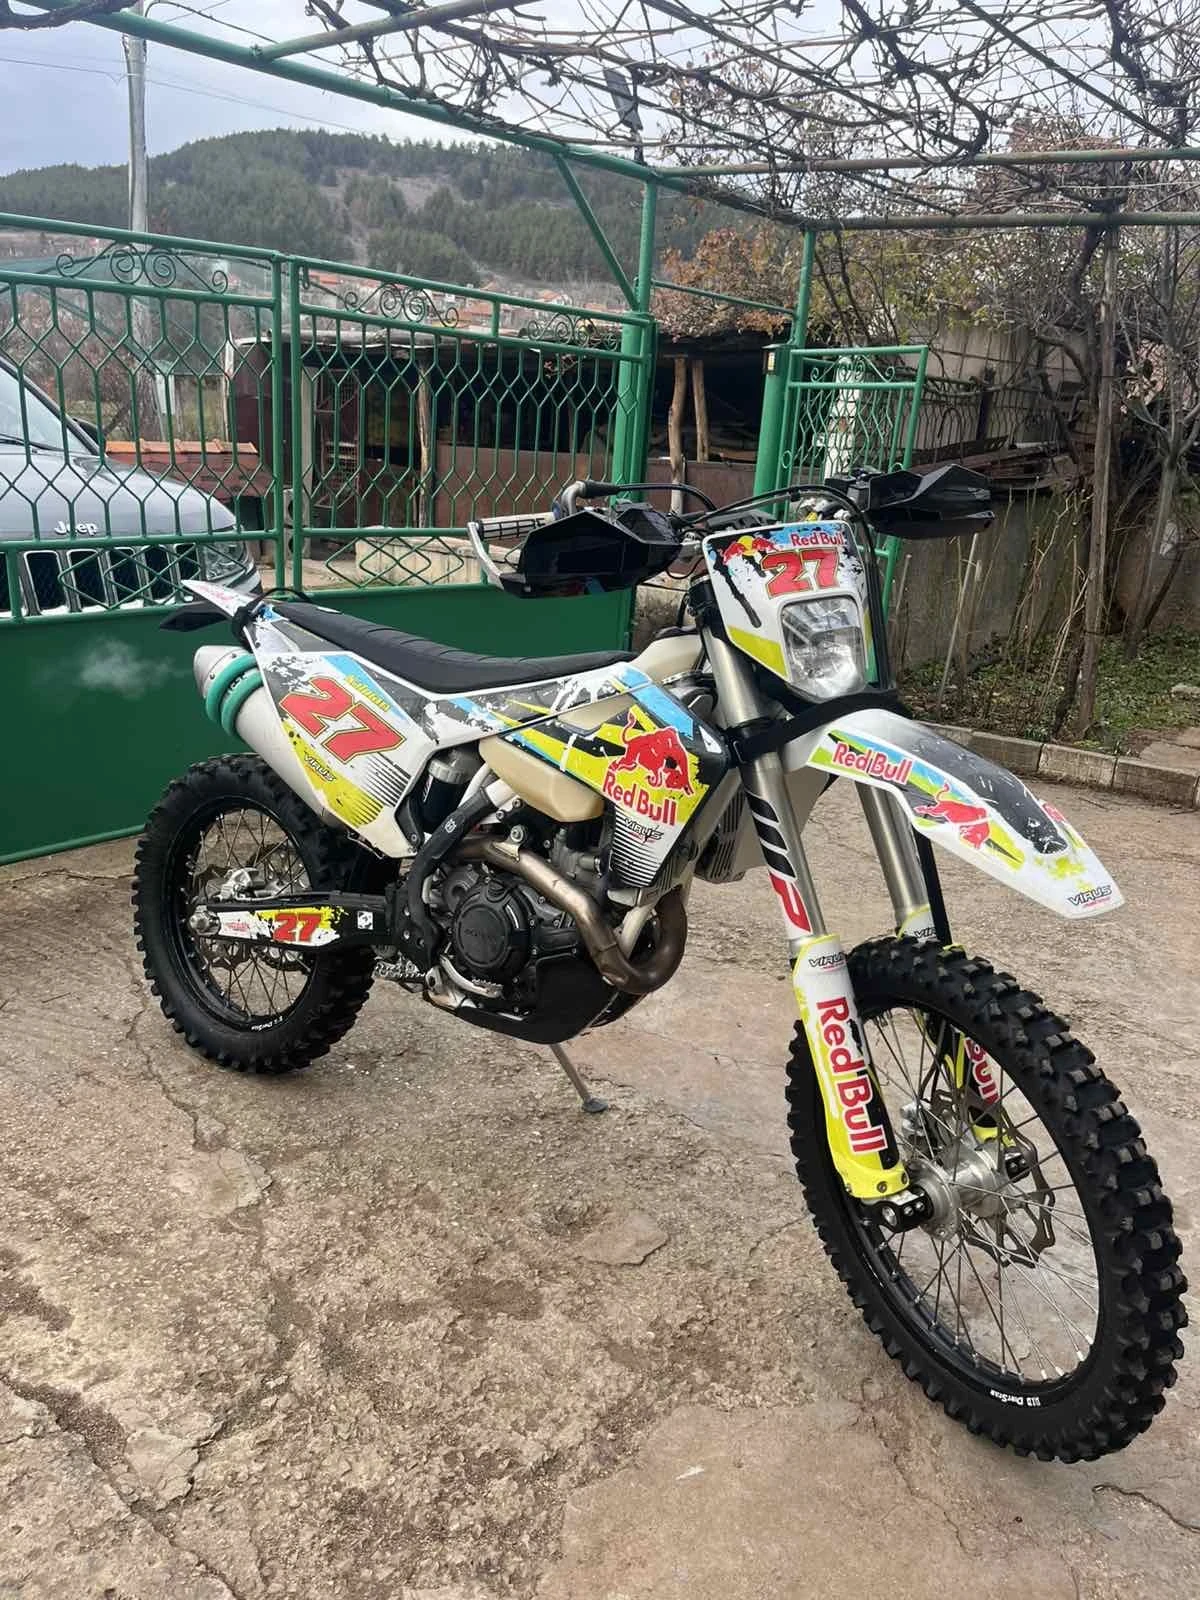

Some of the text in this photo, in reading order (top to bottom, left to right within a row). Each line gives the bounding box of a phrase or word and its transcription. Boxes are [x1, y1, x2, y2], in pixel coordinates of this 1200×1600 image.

[791, 532, 845, 547] Red Bull
[761, 548, 840, 599] 27
[279, 675, 407, 764] 27
[833, 742, 913, 785] Red Bull
[602, 772, 678, 827] Red Bull
[1068, 885, 1112, 906] VIRUS
[272, 912, 323, 943] 27
[816, 996, 866, 1074] Red
[837, 1076, 887, 1153] Bull
